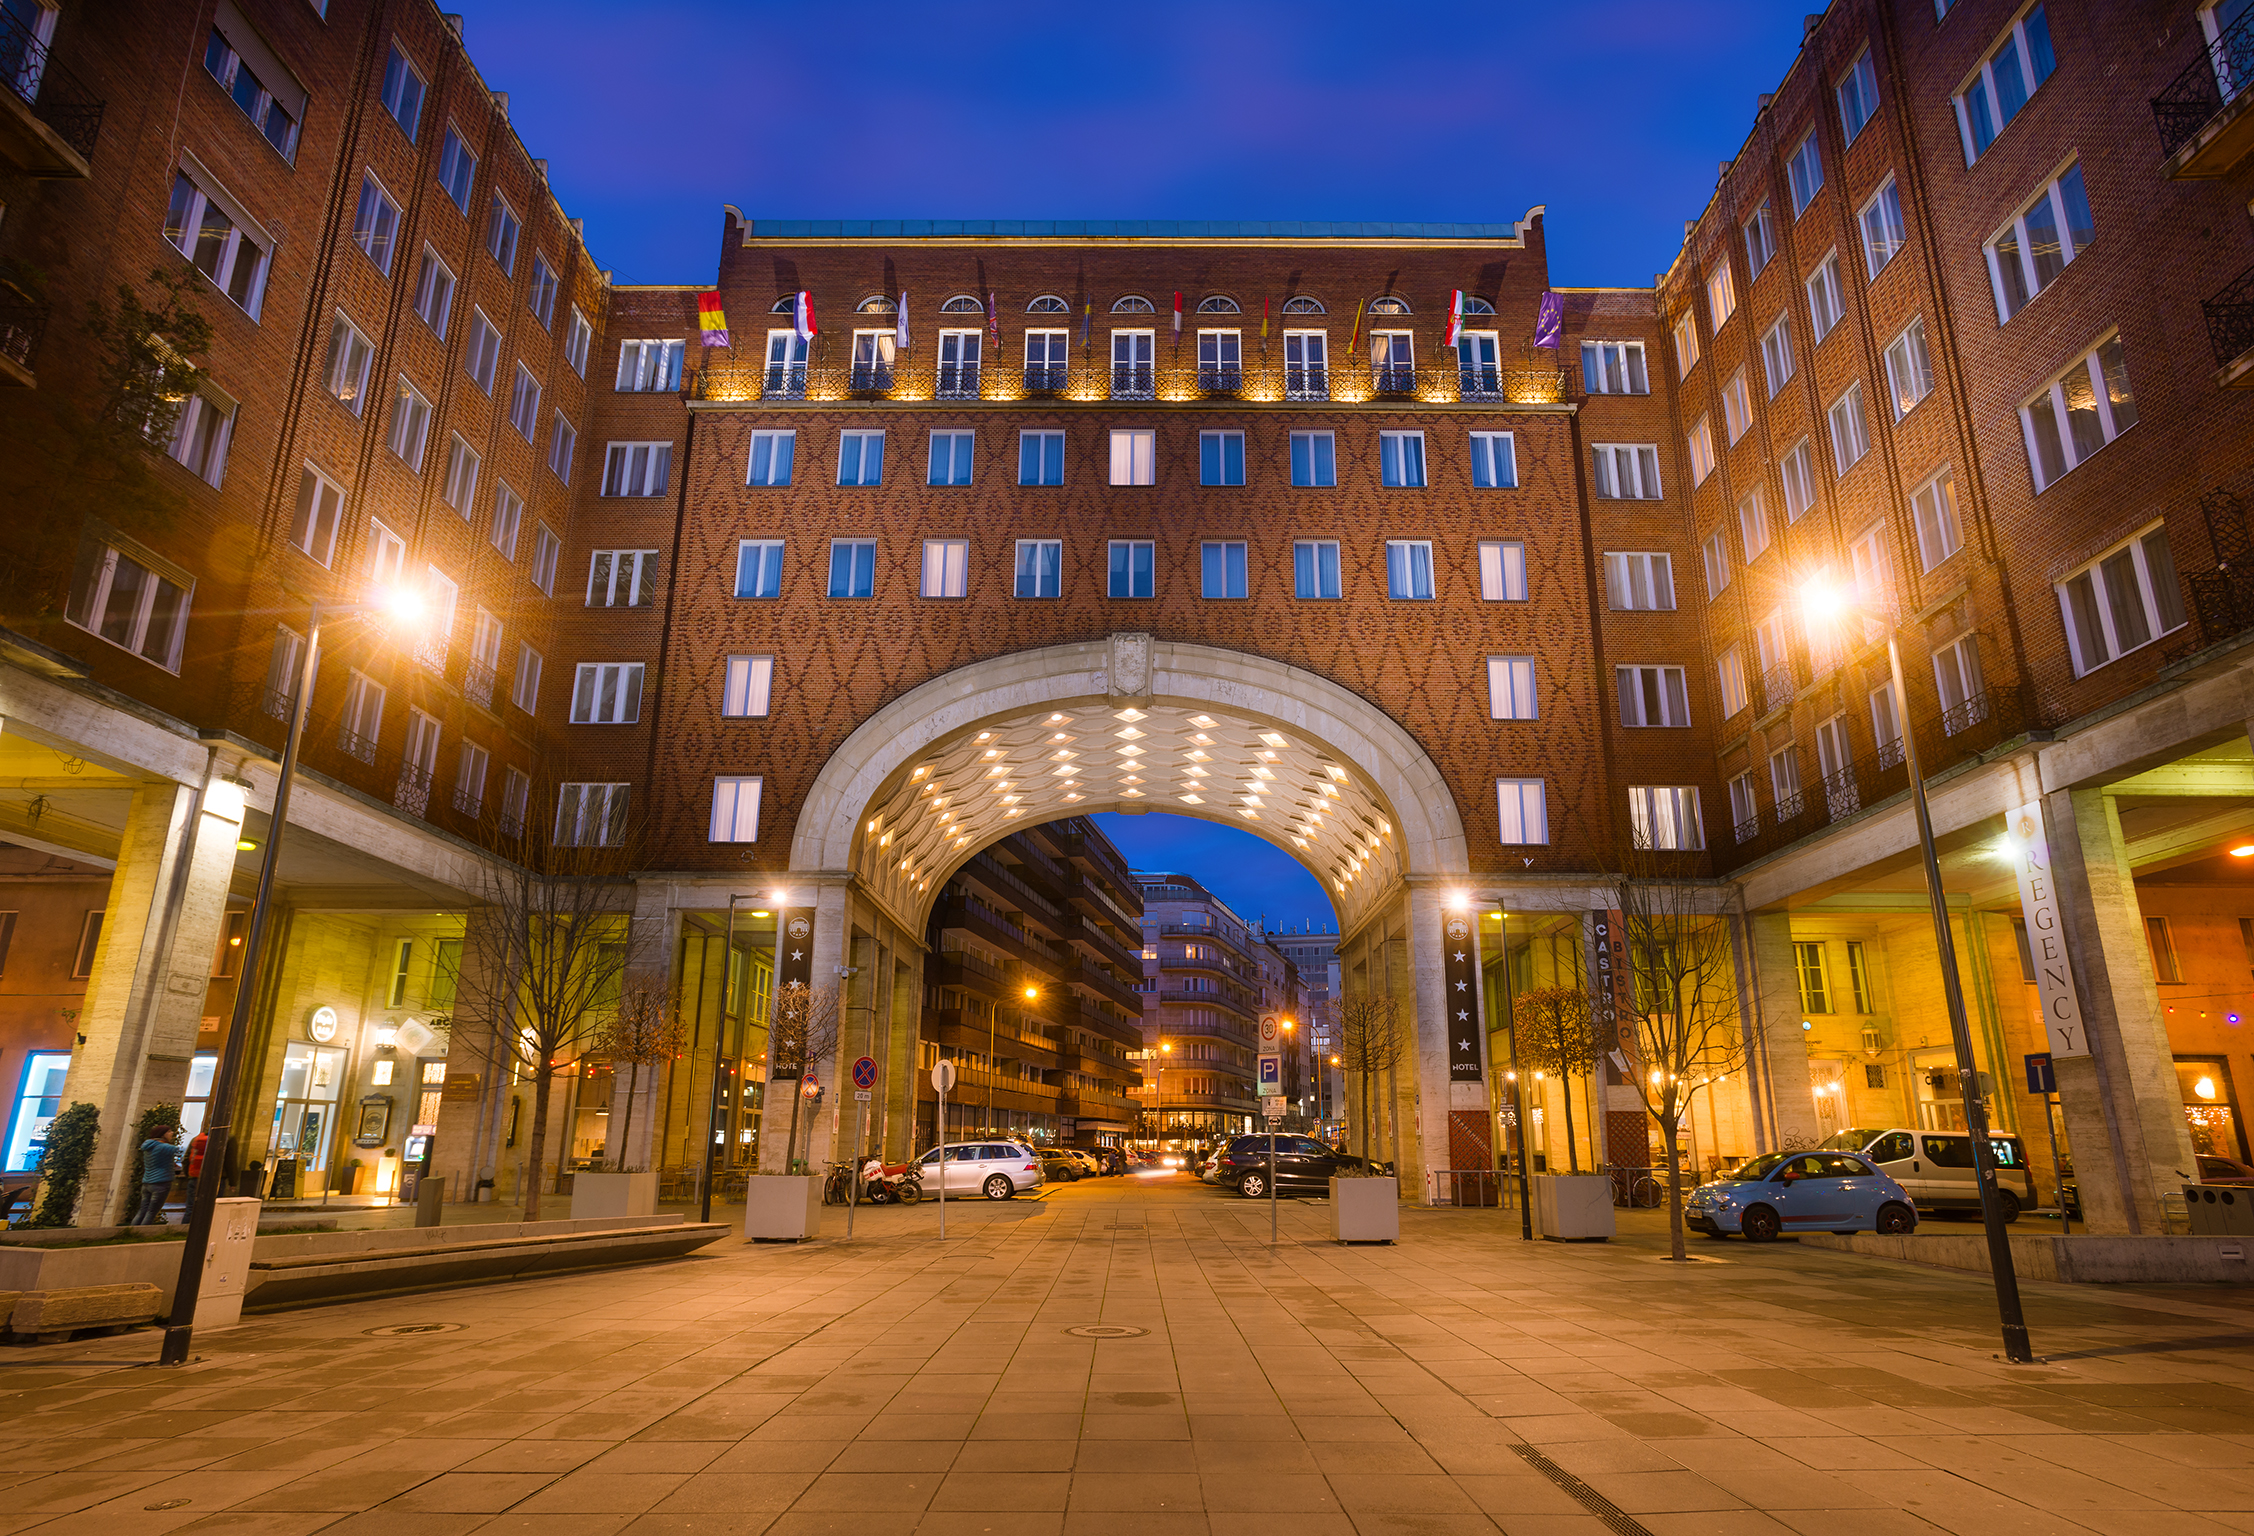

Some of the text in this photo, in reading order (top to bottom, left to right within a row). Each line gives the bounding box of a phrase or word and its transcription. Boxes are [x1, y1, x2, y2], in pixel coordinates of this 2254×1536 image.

[2025, 850, 2075, 1052] REGENCY
[1613, 941, 1632, 1039] BISTRO
[1265, 1024, 1274, 1034] 30
[775, 1062, 799, 1070] HOTE
[1263, 1062, 1274, 1079] P
[1452, 1063, 1479, 1071] HOTEL
